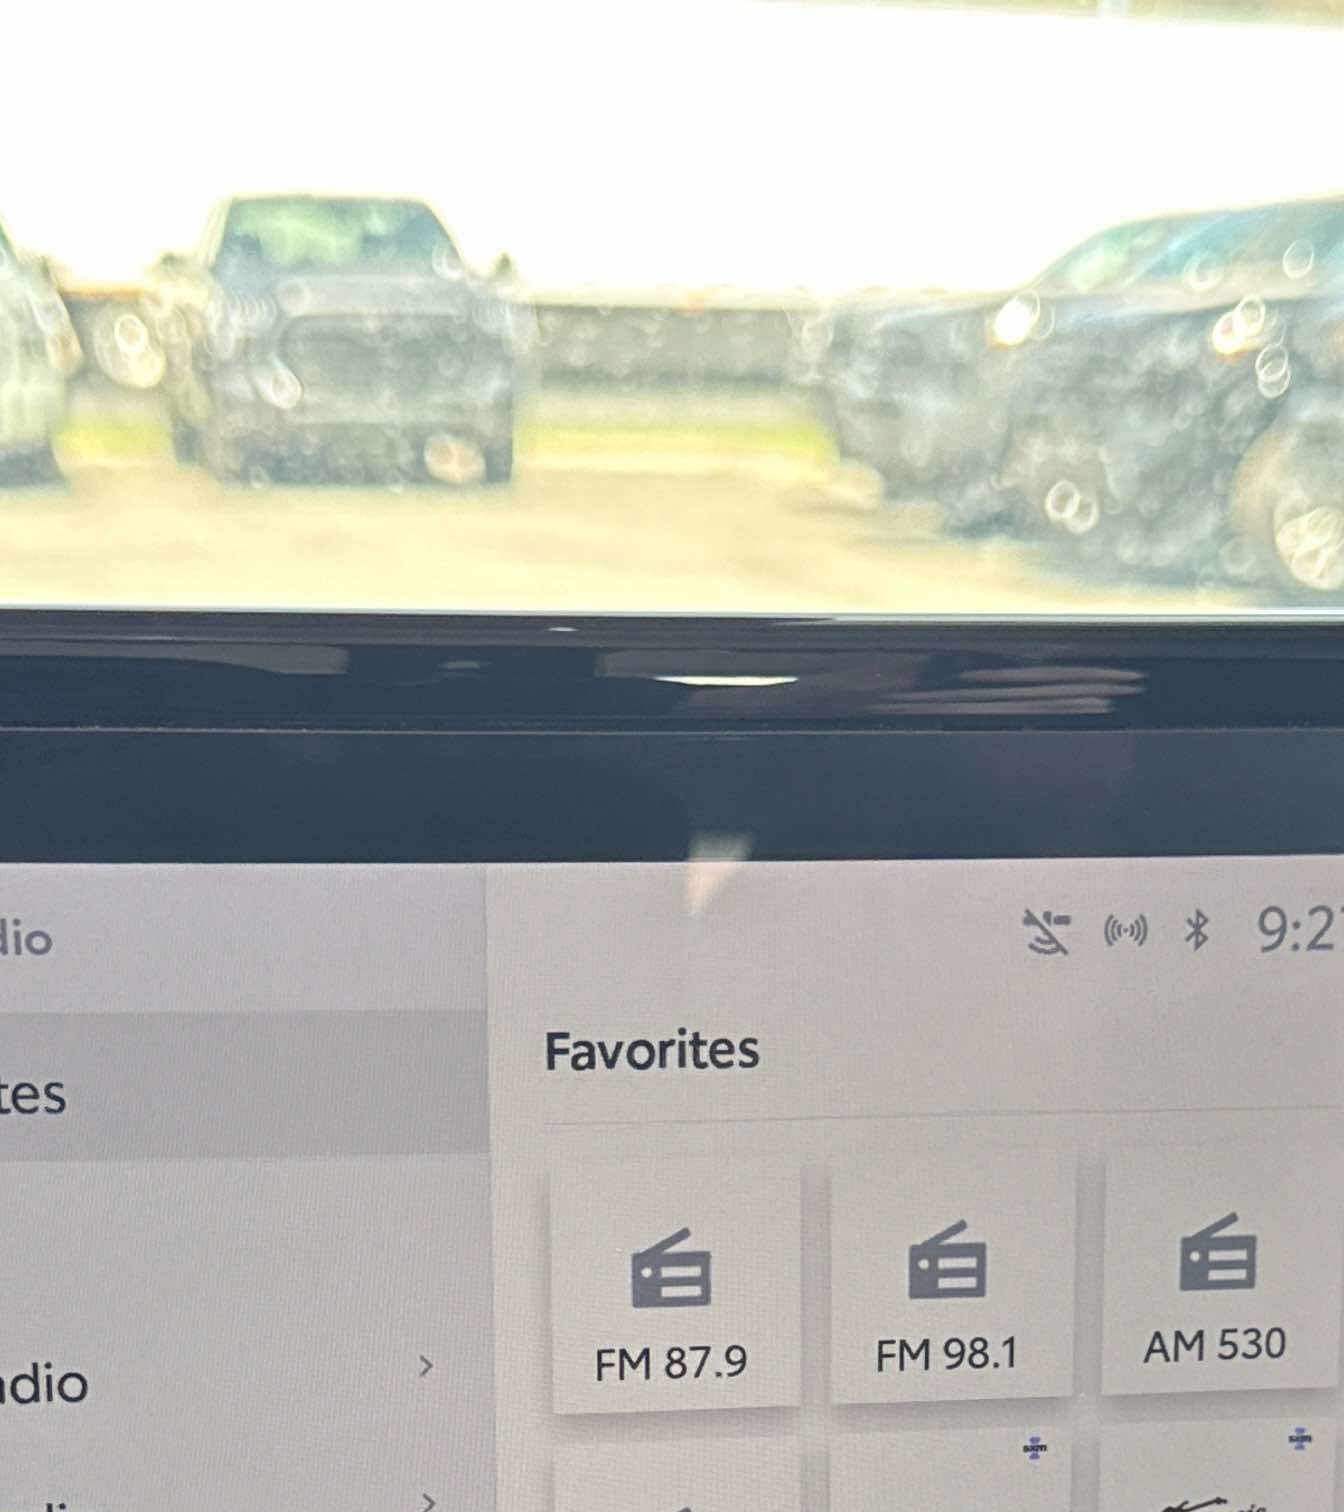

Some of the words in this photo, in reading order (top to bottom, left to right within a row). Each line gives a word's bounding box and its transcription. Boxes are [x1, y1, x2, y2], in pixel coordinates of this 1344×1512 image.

[547, 1027, 759, 1071] Favorites
[597, 1348, 650, 1381] FM
[665, 1345, 746, 1379] 87.9
[878, 1339, 930, 1372] FM
[944, 1336, 1014, 1369] 98.1
[1144, 1330, 1204, 1363] AM
[1218, 1327, 1285, 1360] 530
